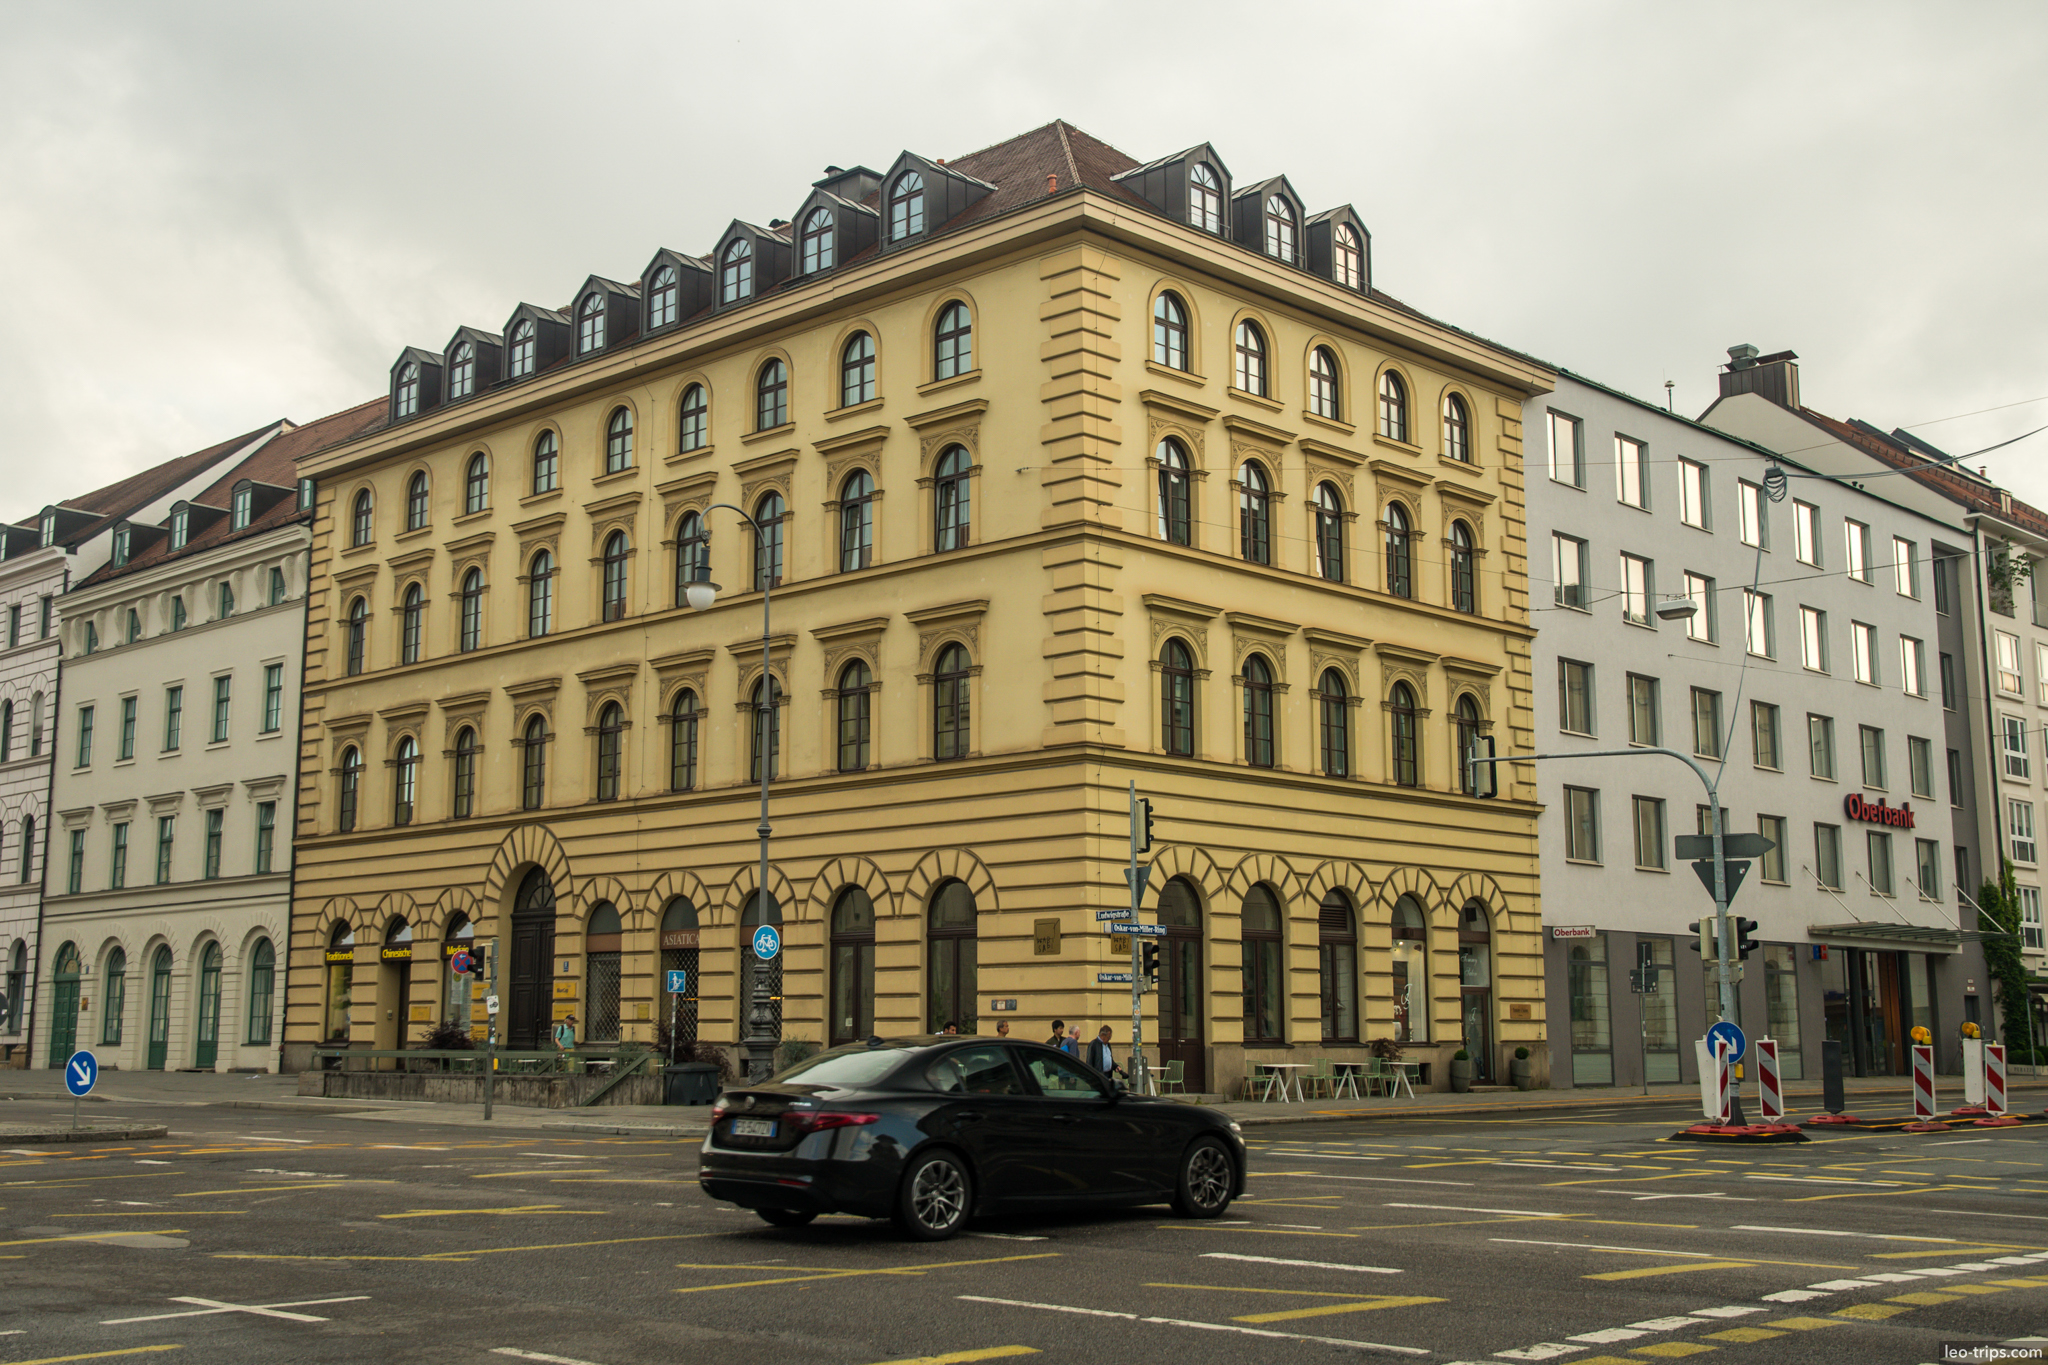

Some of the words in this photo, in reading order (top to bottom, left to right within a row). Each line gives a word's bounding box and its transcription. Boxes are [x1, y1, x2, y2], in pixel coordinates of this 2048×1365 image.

[1844, 793, 1916, 828] Oberbank
[1114, 924, 1166, 934] Oskar-von-Miller-Ring
[1554, 927, 1591, 937] Oberbank
[663, 933, 699, 946] ASIATICA
